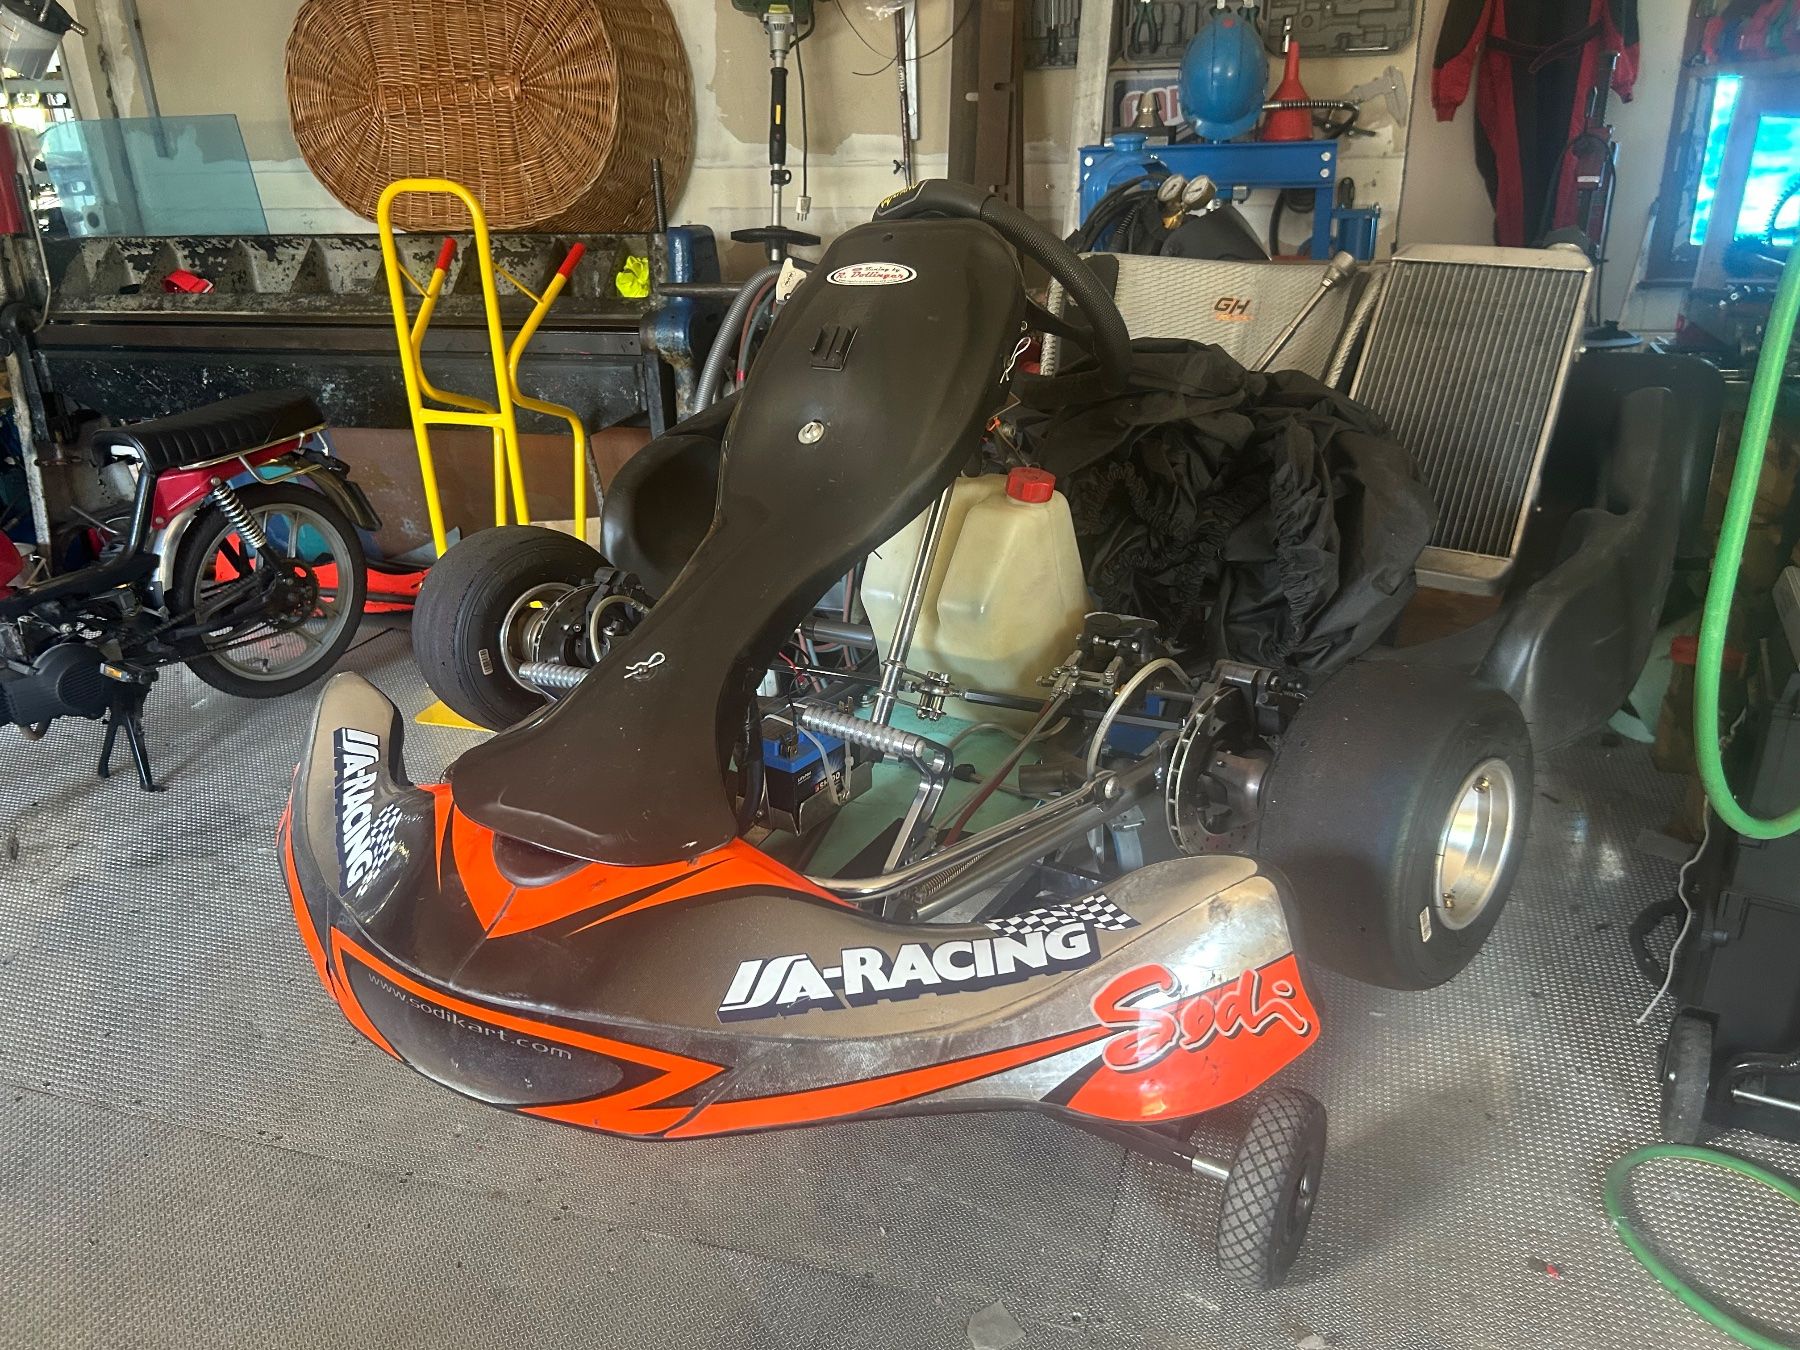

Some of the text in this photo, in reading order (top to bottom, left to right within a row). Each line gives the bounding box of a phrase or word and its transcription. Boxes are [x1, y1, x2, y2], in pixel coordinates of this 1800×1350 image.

[1214, 297, 1251, 315] GH
[368, 972, 572, 1060] www.sodikart.com
[1090, 962, 1311, 1072] Sodi
